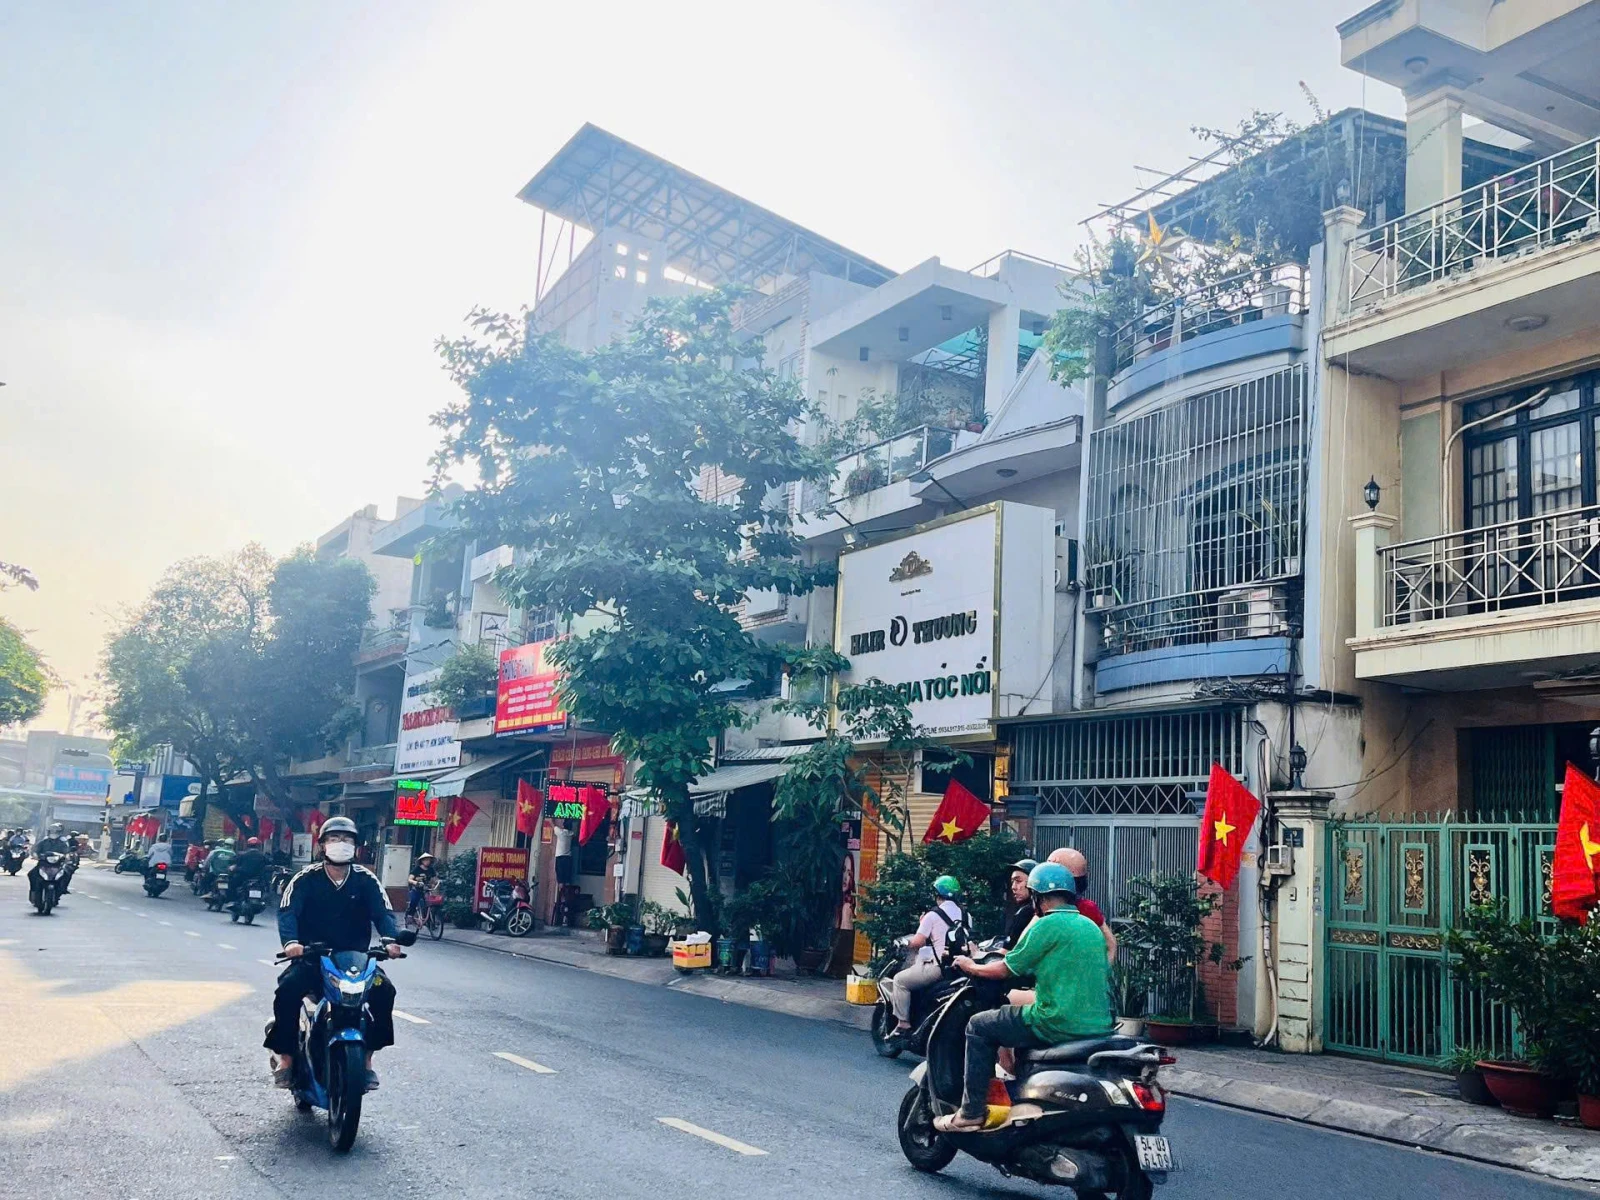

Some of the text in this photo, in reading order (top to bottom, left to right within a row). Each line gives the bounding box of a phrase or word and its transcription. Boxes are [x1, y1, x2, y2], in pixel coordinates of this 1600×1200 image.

[851, 630, 885, 655] HAIR
[923, 663, 958, 700] TÓC
[549, 781, 576, 802] PHÒNG
[482, 850, 526, 865] PHÒNG TRANH
[481, 864, 503, 878] XƯỞNG
